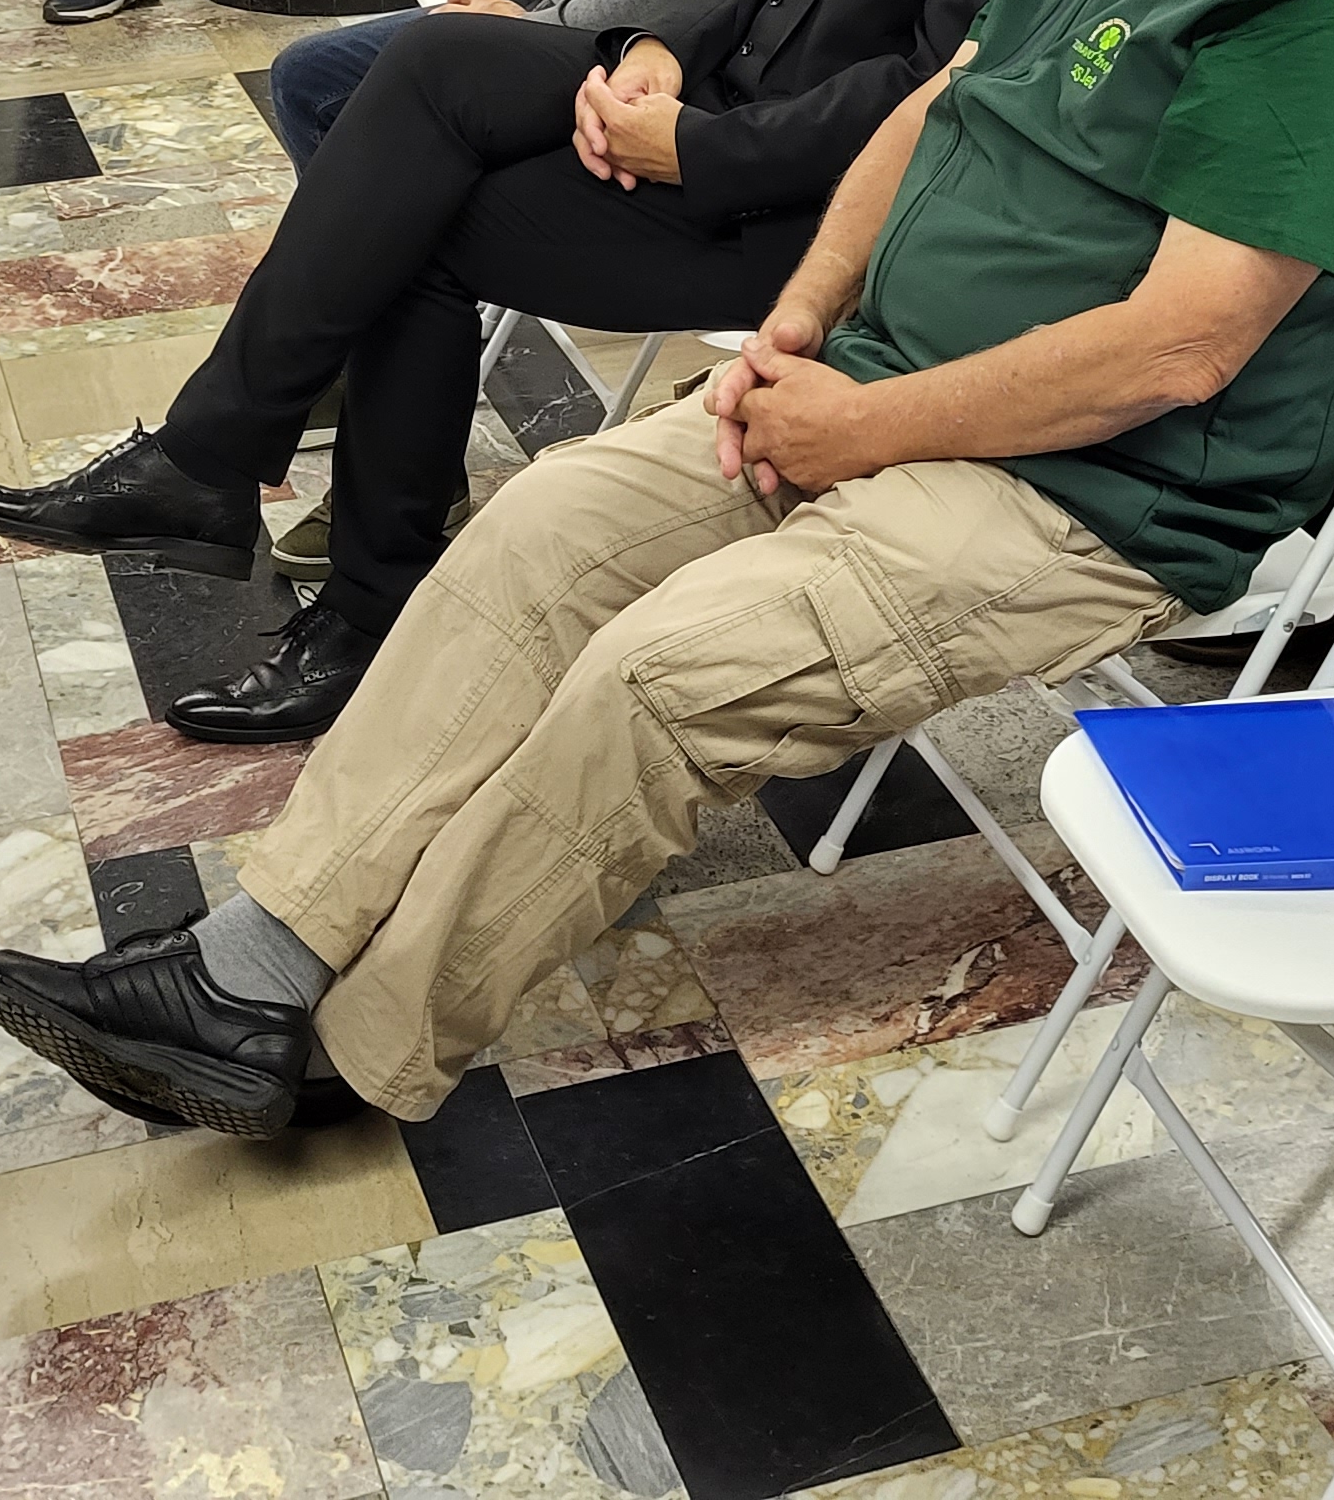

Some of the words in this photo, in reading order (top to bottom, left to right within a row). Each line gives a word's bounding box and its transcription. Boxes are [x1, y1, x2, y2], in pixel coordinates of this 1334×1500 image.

[1080, 67, 1097, 90] let
[1227, 845, 1281, 855] AURORA
[1204, 874, 1237, 883] DISPLAY
[1238, 873, 1259, 881] BOOK
